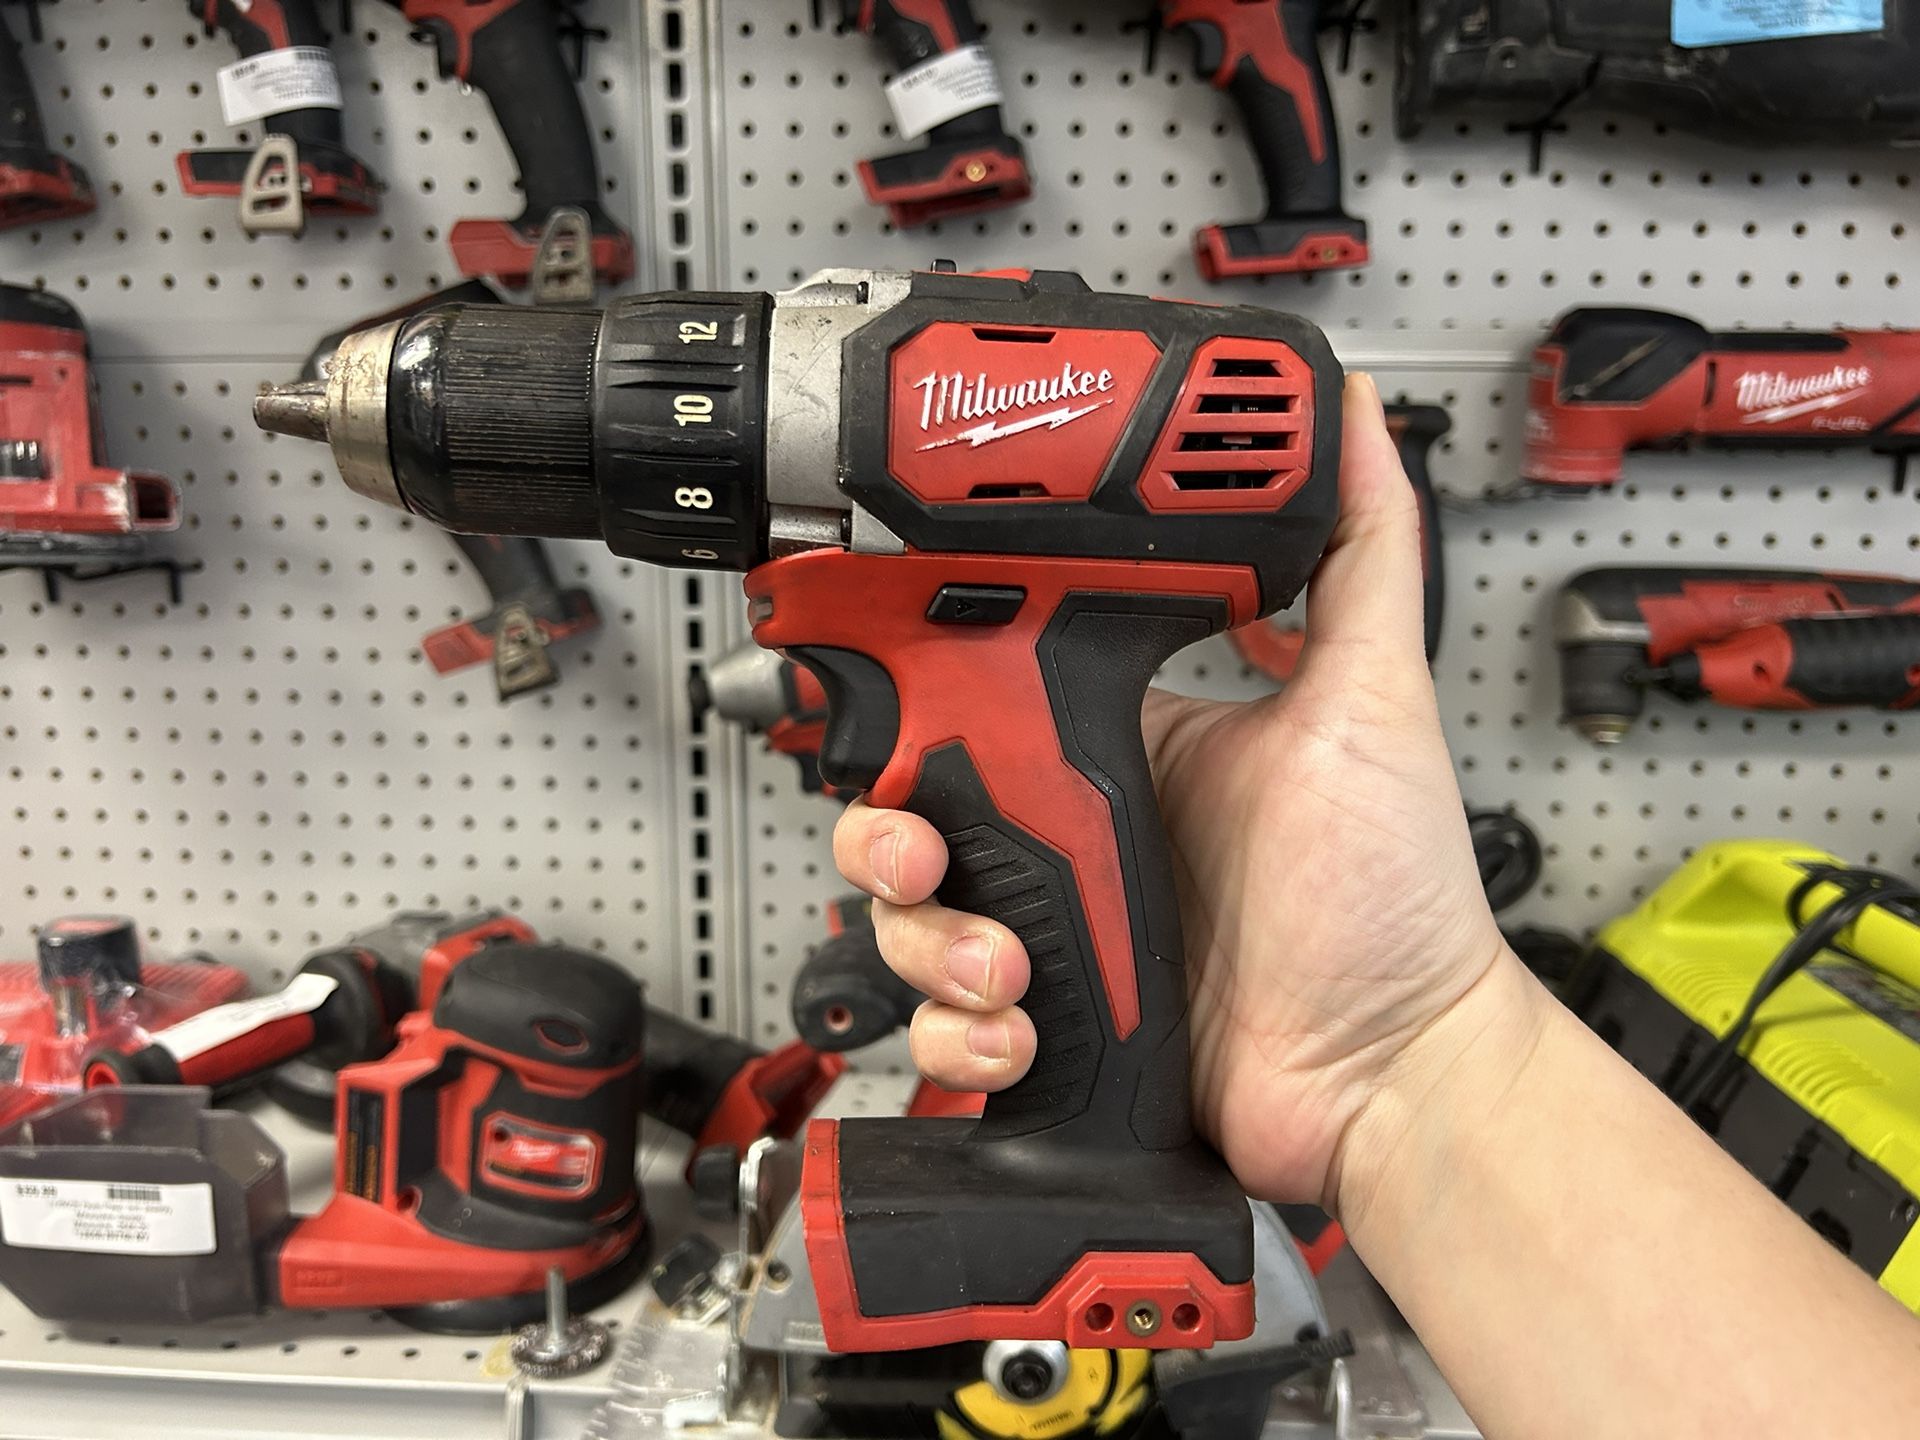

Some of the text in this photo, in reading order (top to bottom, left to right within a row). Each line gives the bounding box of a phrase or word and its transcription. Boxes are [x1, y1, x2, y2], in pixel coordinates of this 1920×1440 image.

[678, 321, 718, 344] 12
[912, 361, 1115, 431] Milwaukee
[1733, 365, 1872, 412] Milwaukee
[673, 394, 713, 427] 10
[675, 486, 713, 510] 8
[681, 548, 719, 560] 6
